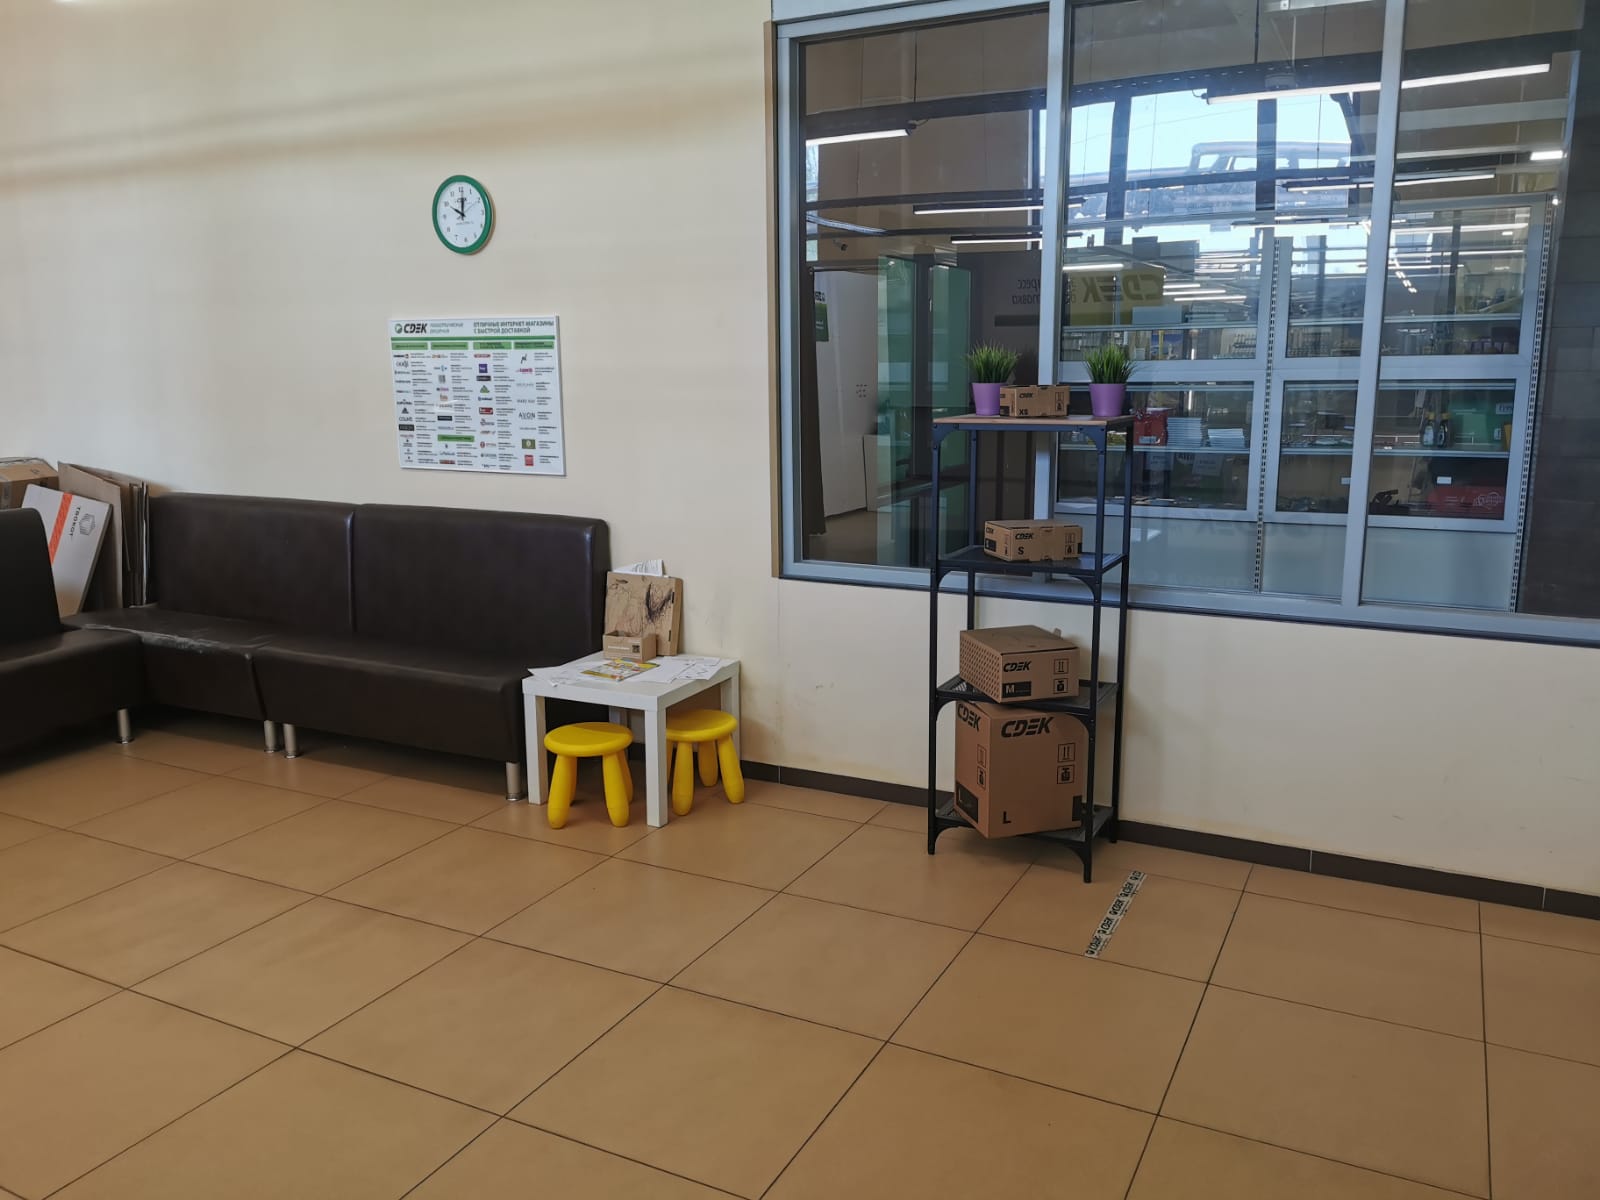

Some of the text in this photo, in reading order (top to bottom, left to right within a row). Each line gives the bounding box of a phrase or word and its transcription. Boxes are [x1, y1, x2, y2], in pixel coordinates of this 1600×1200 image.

[403, 323, 428, 334] CDEK
[1017, 546, 1025, 556] S
[1003, 660, 1032, 673] CDEK
[1005, 684, 1015, 695] M
[957, 702, 981, 732] CDEK
[1001, 716, 1055, 738] CDEK
[1003, 811, 1012, 824] L
